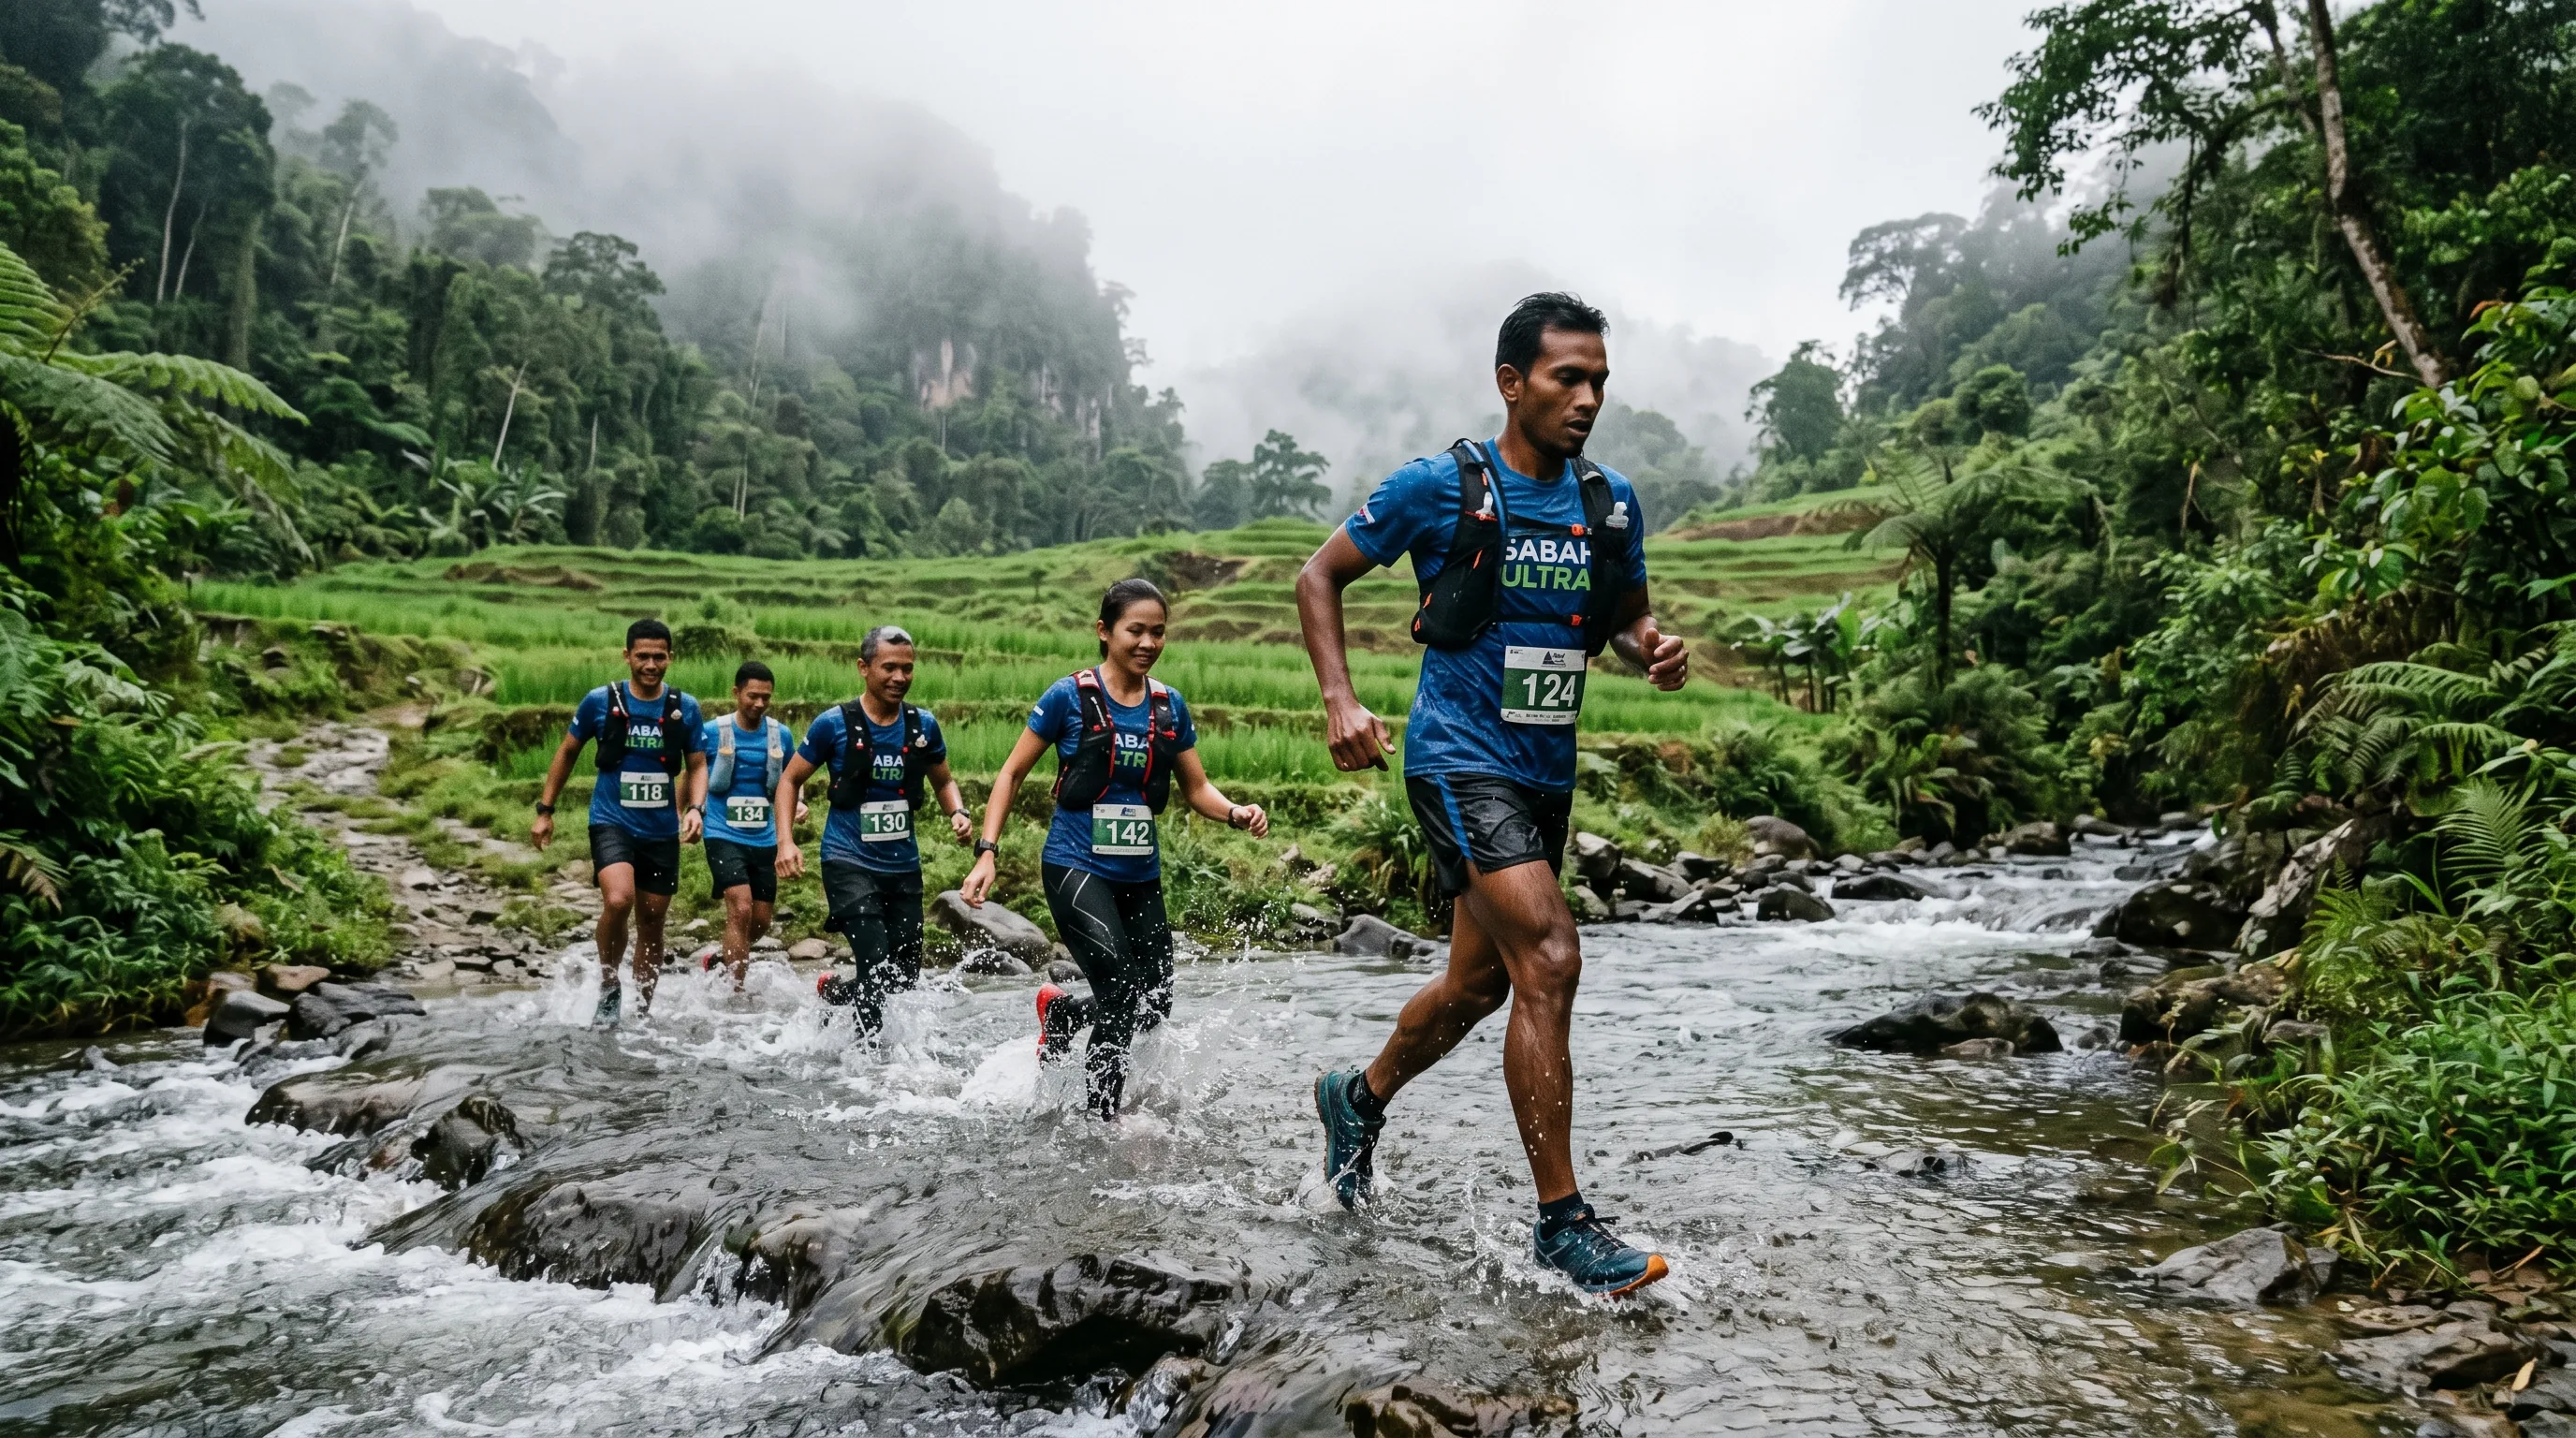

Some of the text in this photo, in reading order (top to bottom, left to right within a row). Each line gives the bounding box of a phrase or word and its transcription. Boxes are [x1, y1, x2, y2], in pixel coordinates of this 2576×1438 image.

[1500, 565, 1591, 591] ULTRA
[1522, 673, 1576, 708] 124
[628, 725, 664, 738] ABA
[1114, 732, 1149, 749] ABA
[872, 755, 904, 767] ABA
[871, 768, 904, 781] LTR
[629, 784, 663, 800] 118
[735, 806, 764, 821] 134
[871, 813, 906, 832] 130
[1106, 820, 1149, 845] 142
